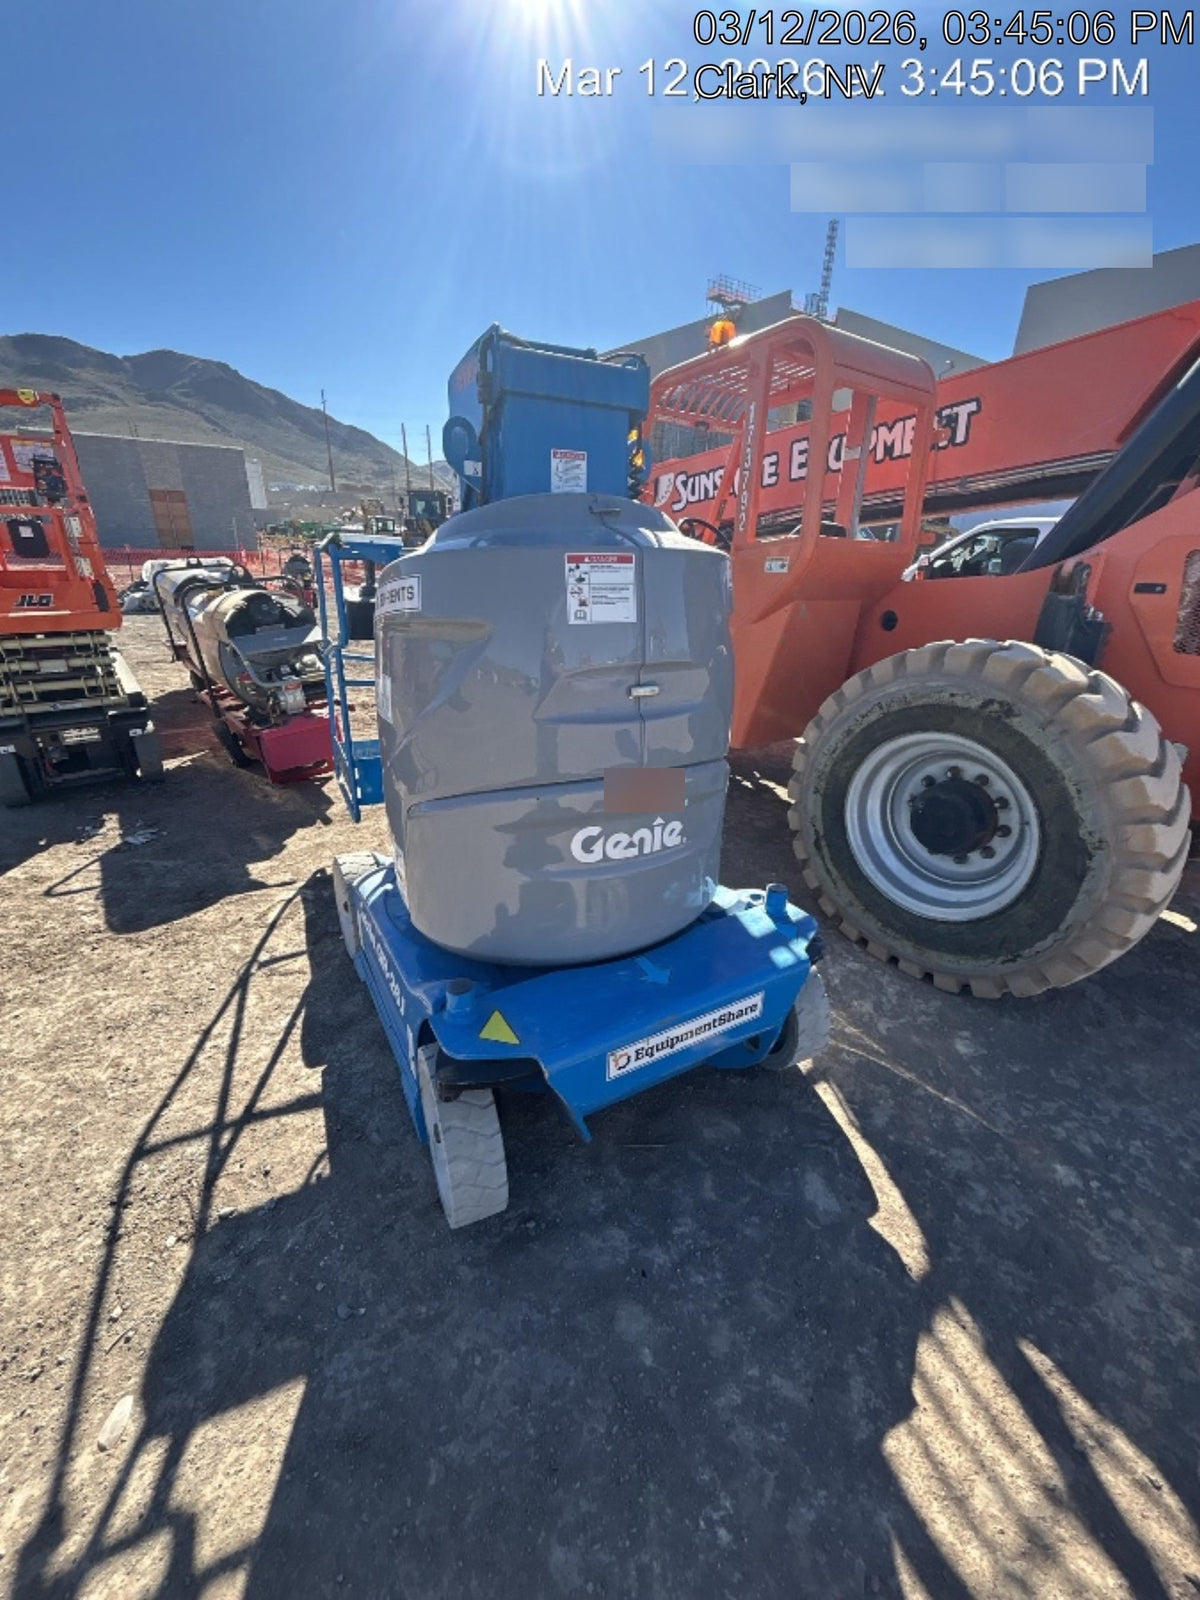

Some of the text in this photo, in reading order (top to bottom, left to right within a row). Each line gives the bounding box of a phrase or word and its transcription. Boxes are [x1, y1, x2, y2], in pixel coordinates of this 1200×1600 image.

[671, 451, 780, 513] SUNSE
[570, 816, 684, 863] Genie
[633, 1002, 759, 1063] EquipmentShare
